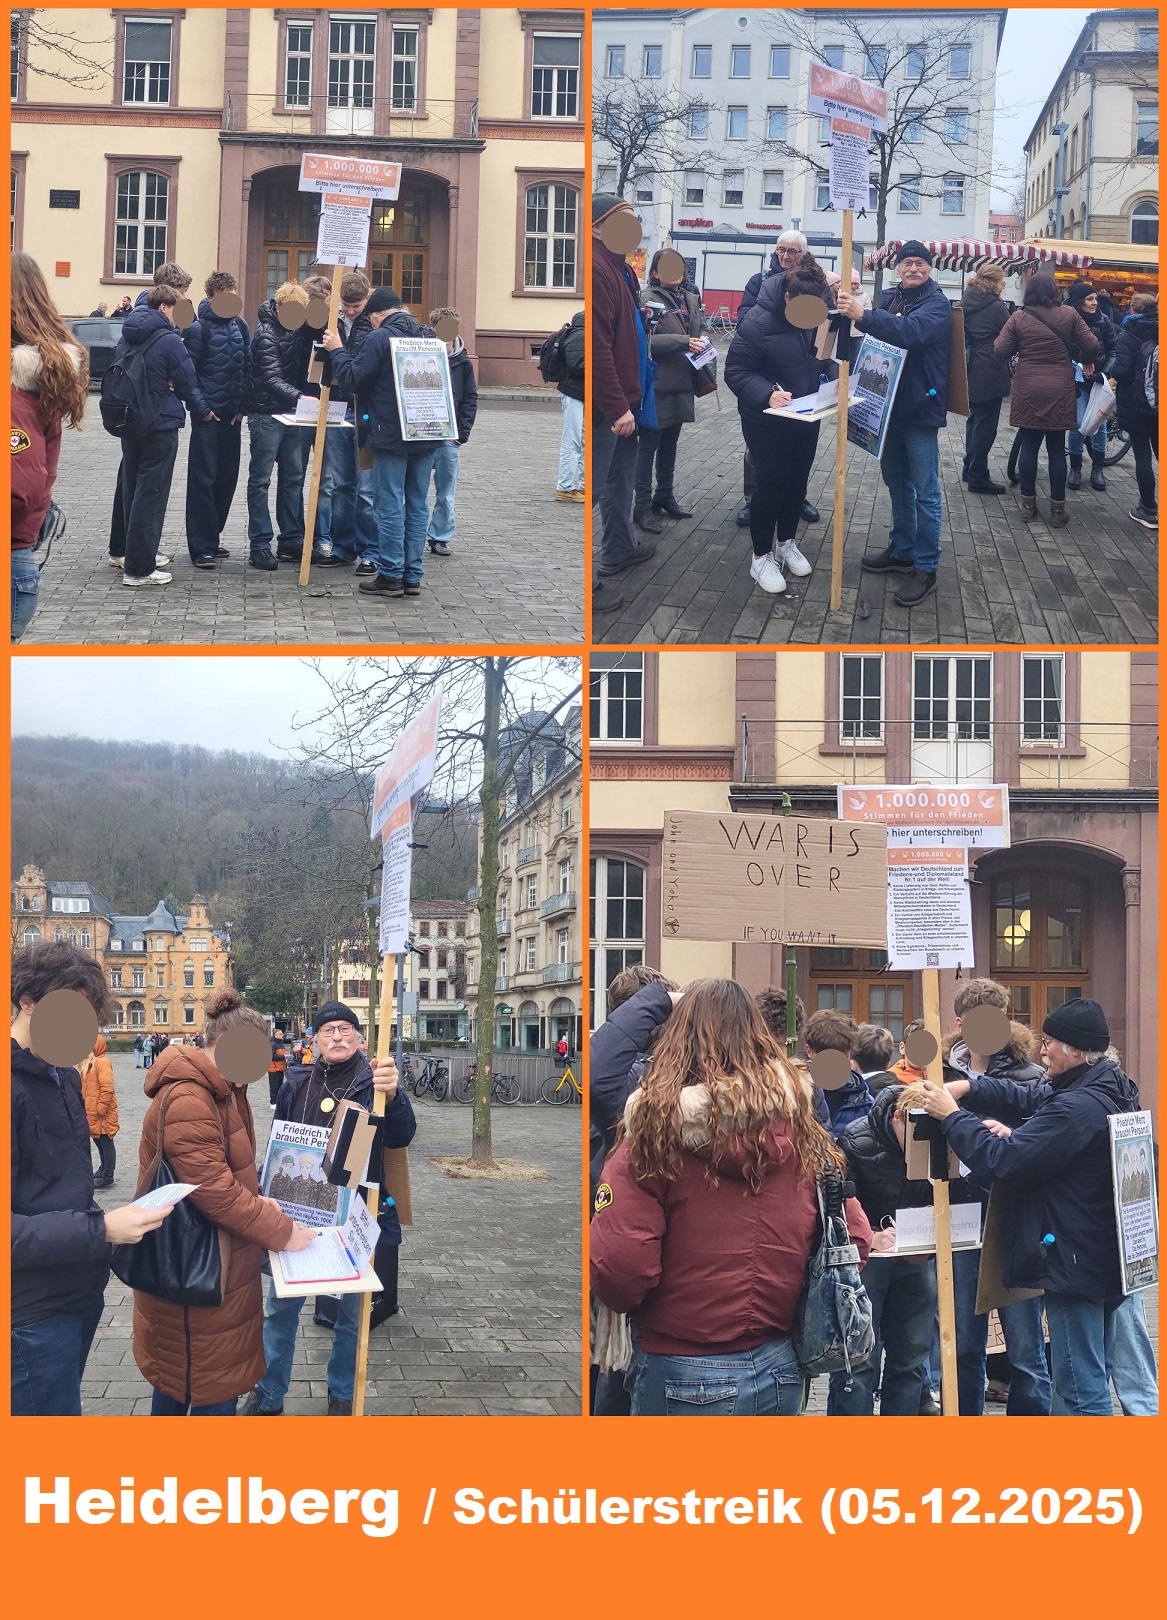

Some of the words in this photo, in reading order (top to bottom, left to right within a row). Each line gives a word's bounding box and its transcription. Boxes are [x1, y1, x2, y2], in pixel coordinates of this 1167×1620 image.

[823, 99, 837, 109] Bitte
[837, 104, 848, 112] hier
[324, 160, 379, 175] 1.000.000
[342, 184, 384, 193] unterschreiben!
[677, 217, 714, 229] amplifon
[875, 792, 971, 808] 1.000.000
[863, 811, 907, 820] Stimmen
[910, 811, 924, 819] für
[928, 811, 945, 819] den
[948, 810, 984, 819] Frieden
[669, 818, 682, 844] John
[891, 828, 910, 837] hier
[912, 828, 983, 838] unterschreiben!
[718, 819, 809, 859] WAR
[829, 825, 862, 857] IS
[669, 853, 678, 872] and
[746, 862, 841, 894] OVER
[668, 877, 680, 911] Yoko
[743, 926, 754, 939] IF
[760, 927, 784, 941] YOU
[787, 930, 822, 943] WANT
[828, 933, 837, 945] IT
[275, 1131, 309, 1145] braucht
[282, 1123, 322, 1139] Friedrich
[1114, 1127, 1131, 1139] braucht
